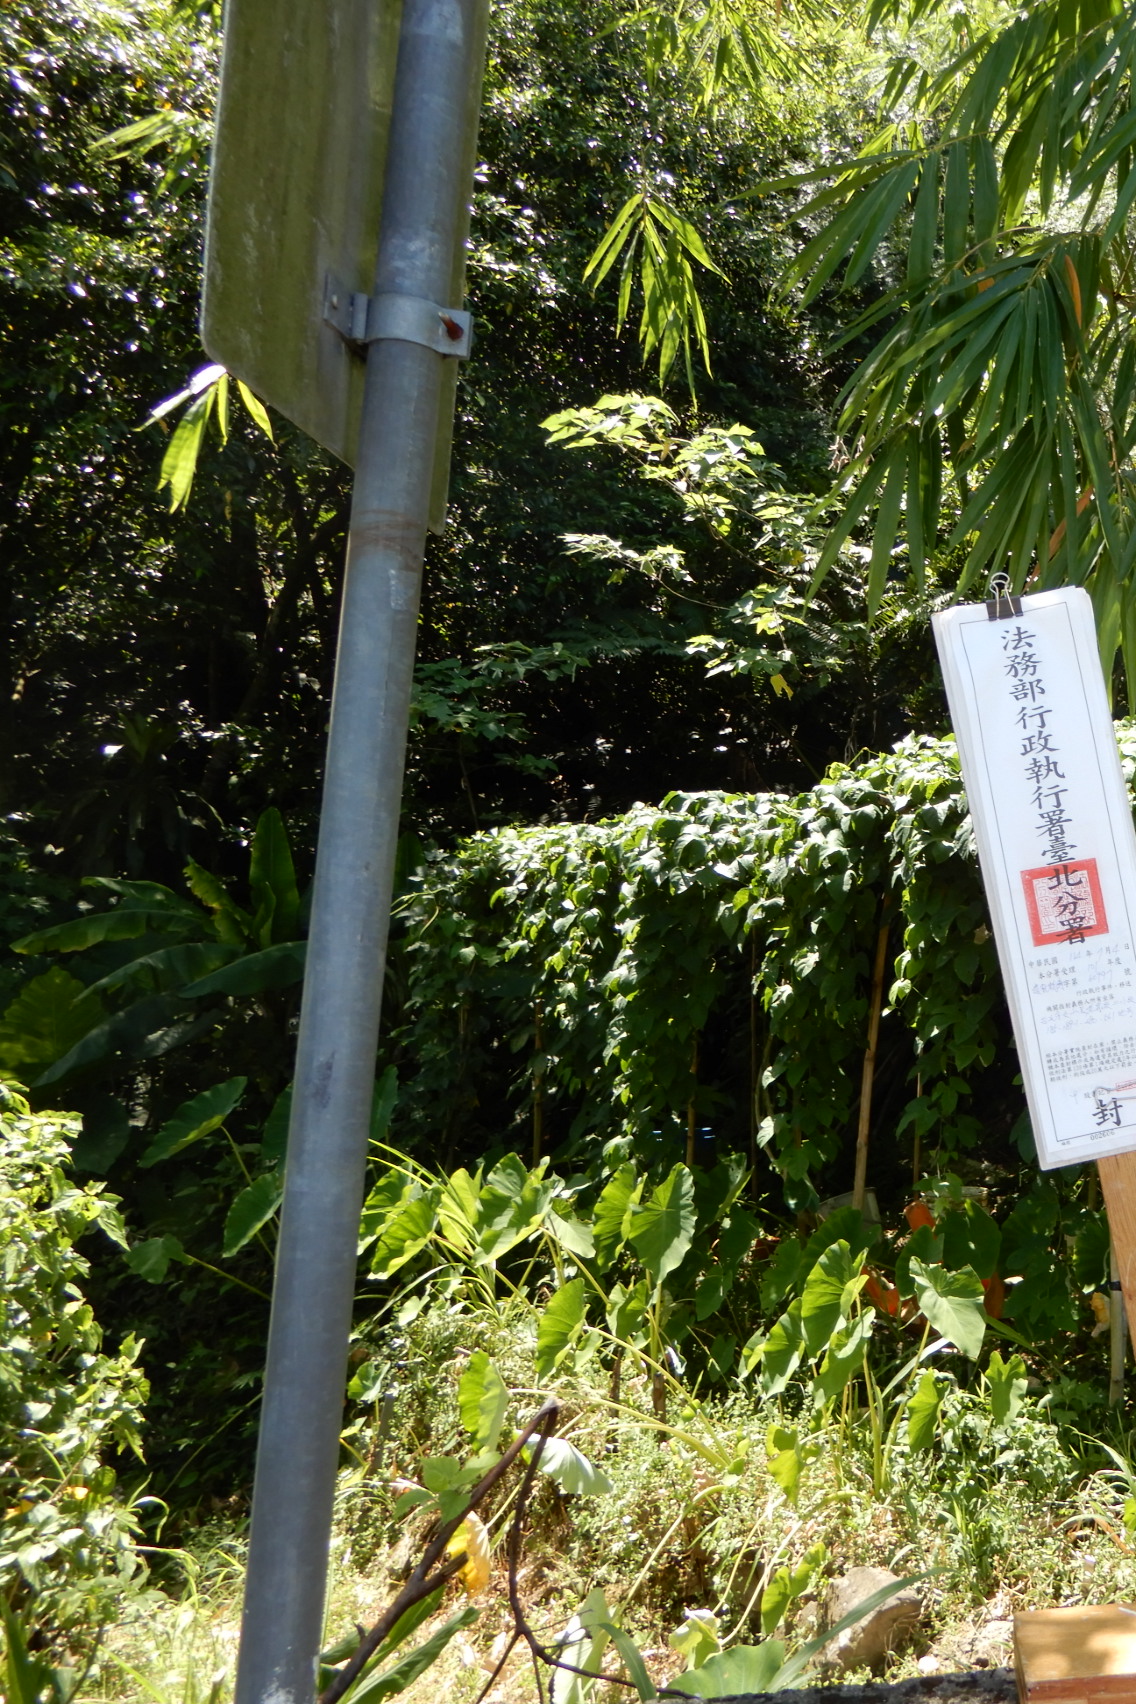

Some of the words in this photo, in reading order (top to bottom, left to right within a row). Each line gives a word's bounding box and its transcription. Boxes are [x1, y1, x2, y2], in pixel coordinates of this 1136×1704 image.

[1000, 626, 1093, 945] 法務部行政執行署臺北分署
[1092, 1097, 1123, 1126] 封
